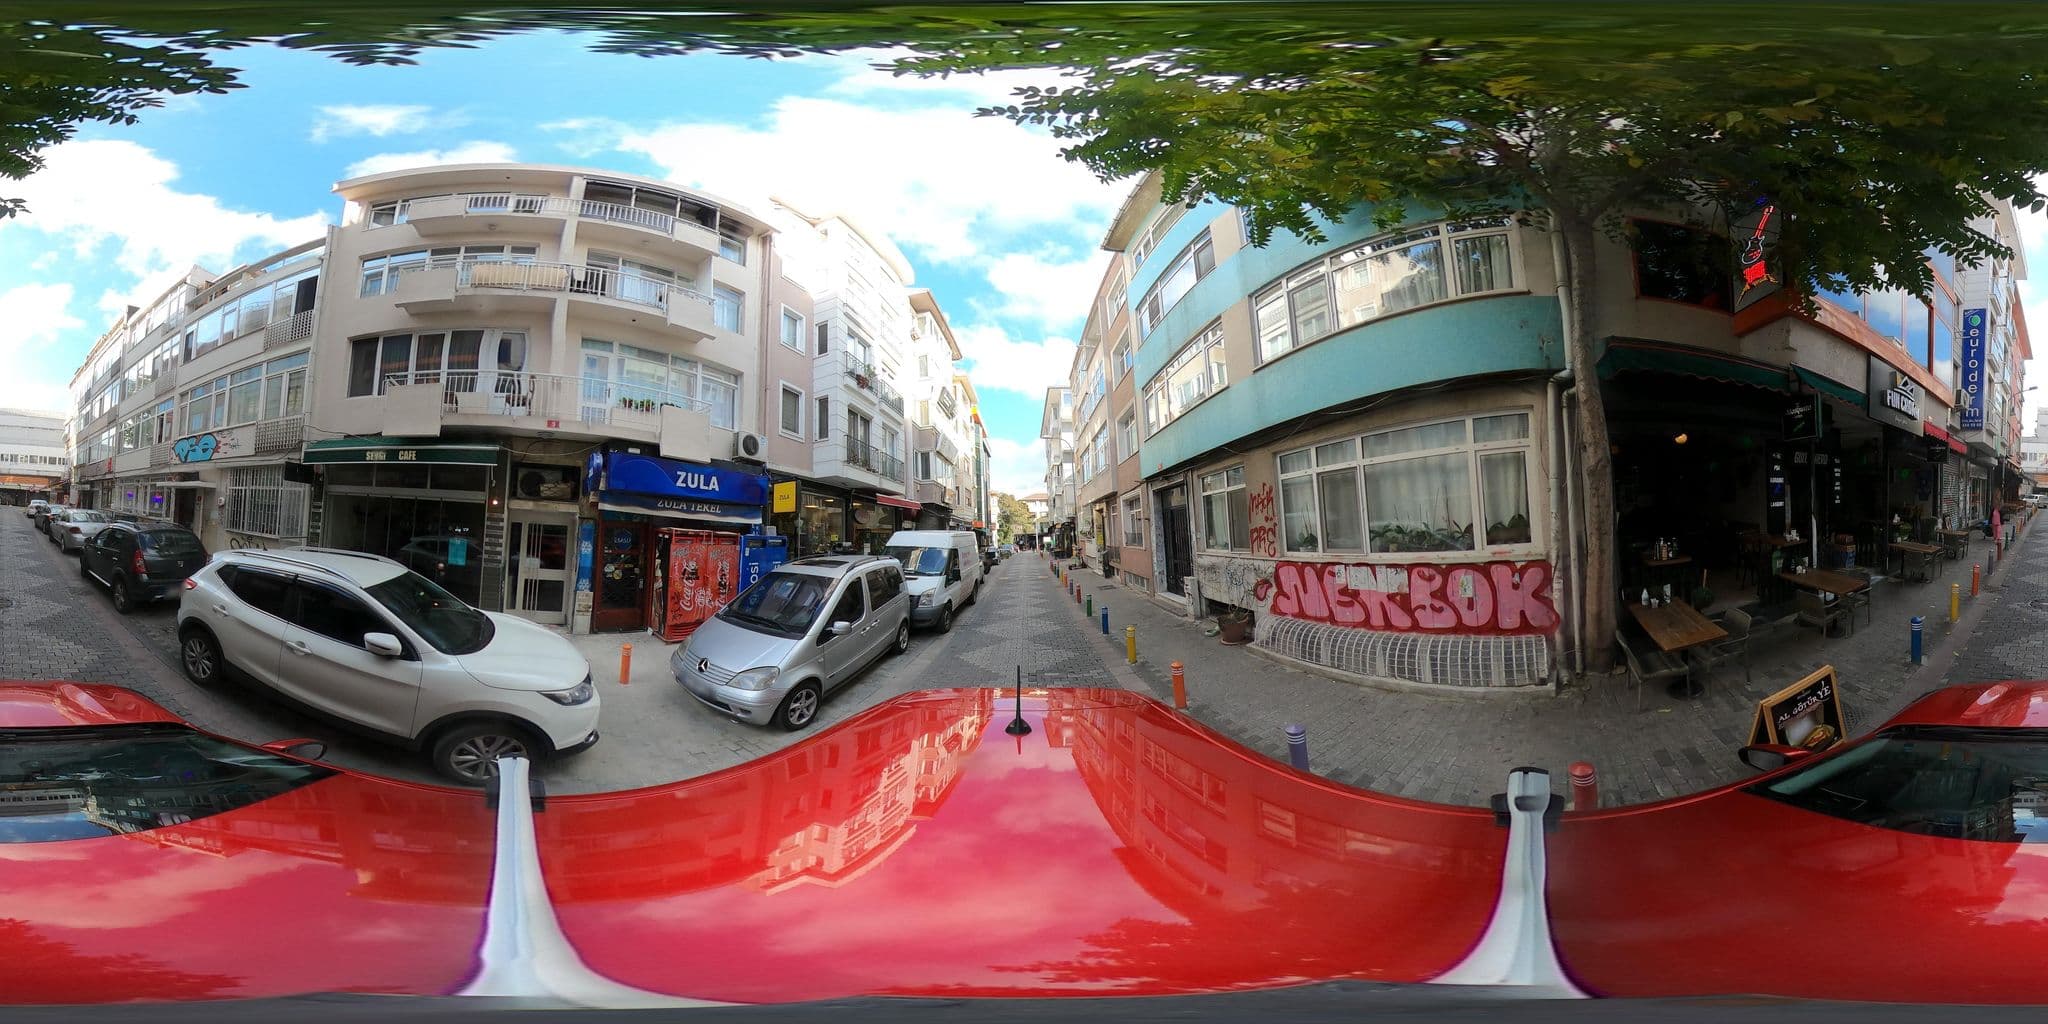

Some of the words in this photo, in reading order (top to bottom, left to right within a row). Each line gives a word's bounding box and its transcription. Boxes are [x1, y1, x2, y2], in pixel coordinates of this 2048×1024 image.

[1965, 327, 1981, 418] euroderm
[398, 450, 417, 461] CAFE
[675, 470, 720, 492] ZULA
[657, 499, 687, 511] ZULA
[690, 502, 722, 514] TEKEL
[1778, 712, 1791, 723] AL
[1792, 695, 1818, 716] GÖTÜR
